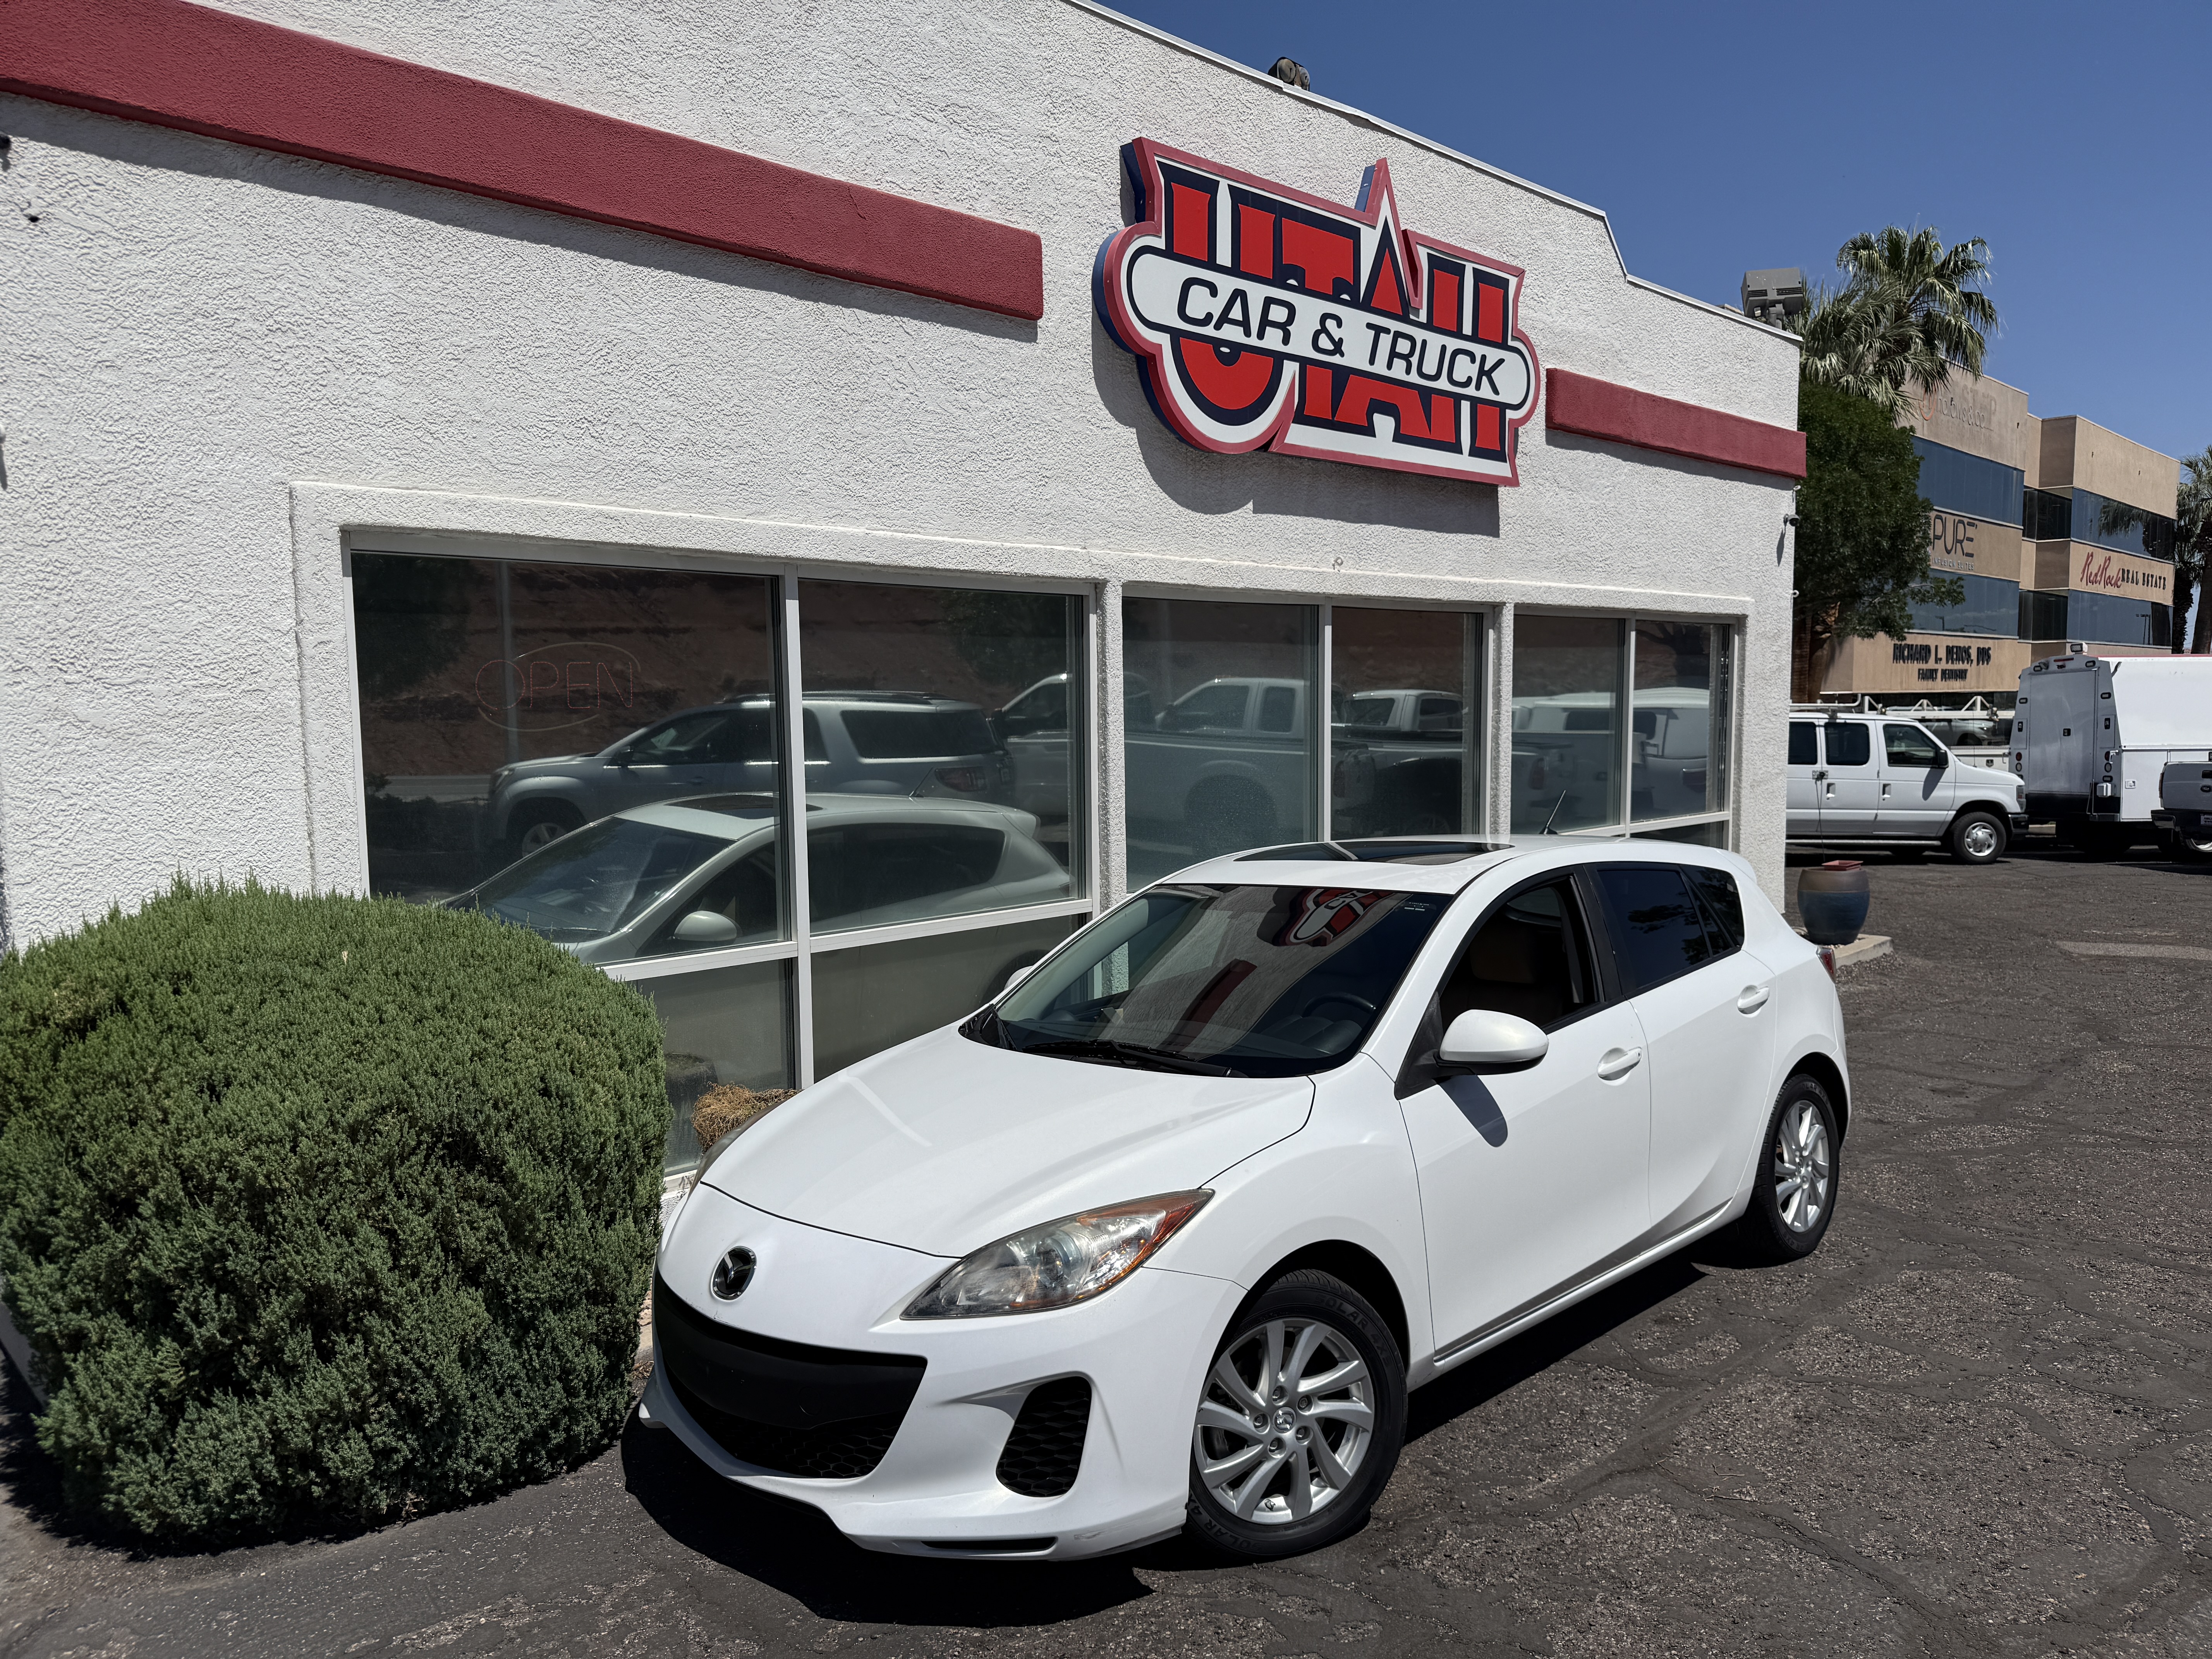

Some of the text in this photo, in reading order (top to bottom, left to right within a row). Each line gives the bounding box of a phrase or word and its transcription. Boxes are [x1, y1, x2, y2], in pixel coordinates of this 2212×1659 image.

[1156, 159, 1512, 463] UTAH
[1177, 276, 1505, 396] CAR & TRUCK
[1933, 514, 1975, 558] PURE
[2121, 568, 2139, 585] REAL
[2142, 572, 2166, 590] ESTATE
[1893, 643, 1931, 663] RICHARD
[1977, 647, 1991, 666] DDS
[476, 660, 632, 710] OPEN
[1918, 668, 1968, 682] FAMILY DENTISTRY
[1314, 1294, 1369, 1330] SOLAR
[1204, 1519, 1264, 1553] SOLAR
